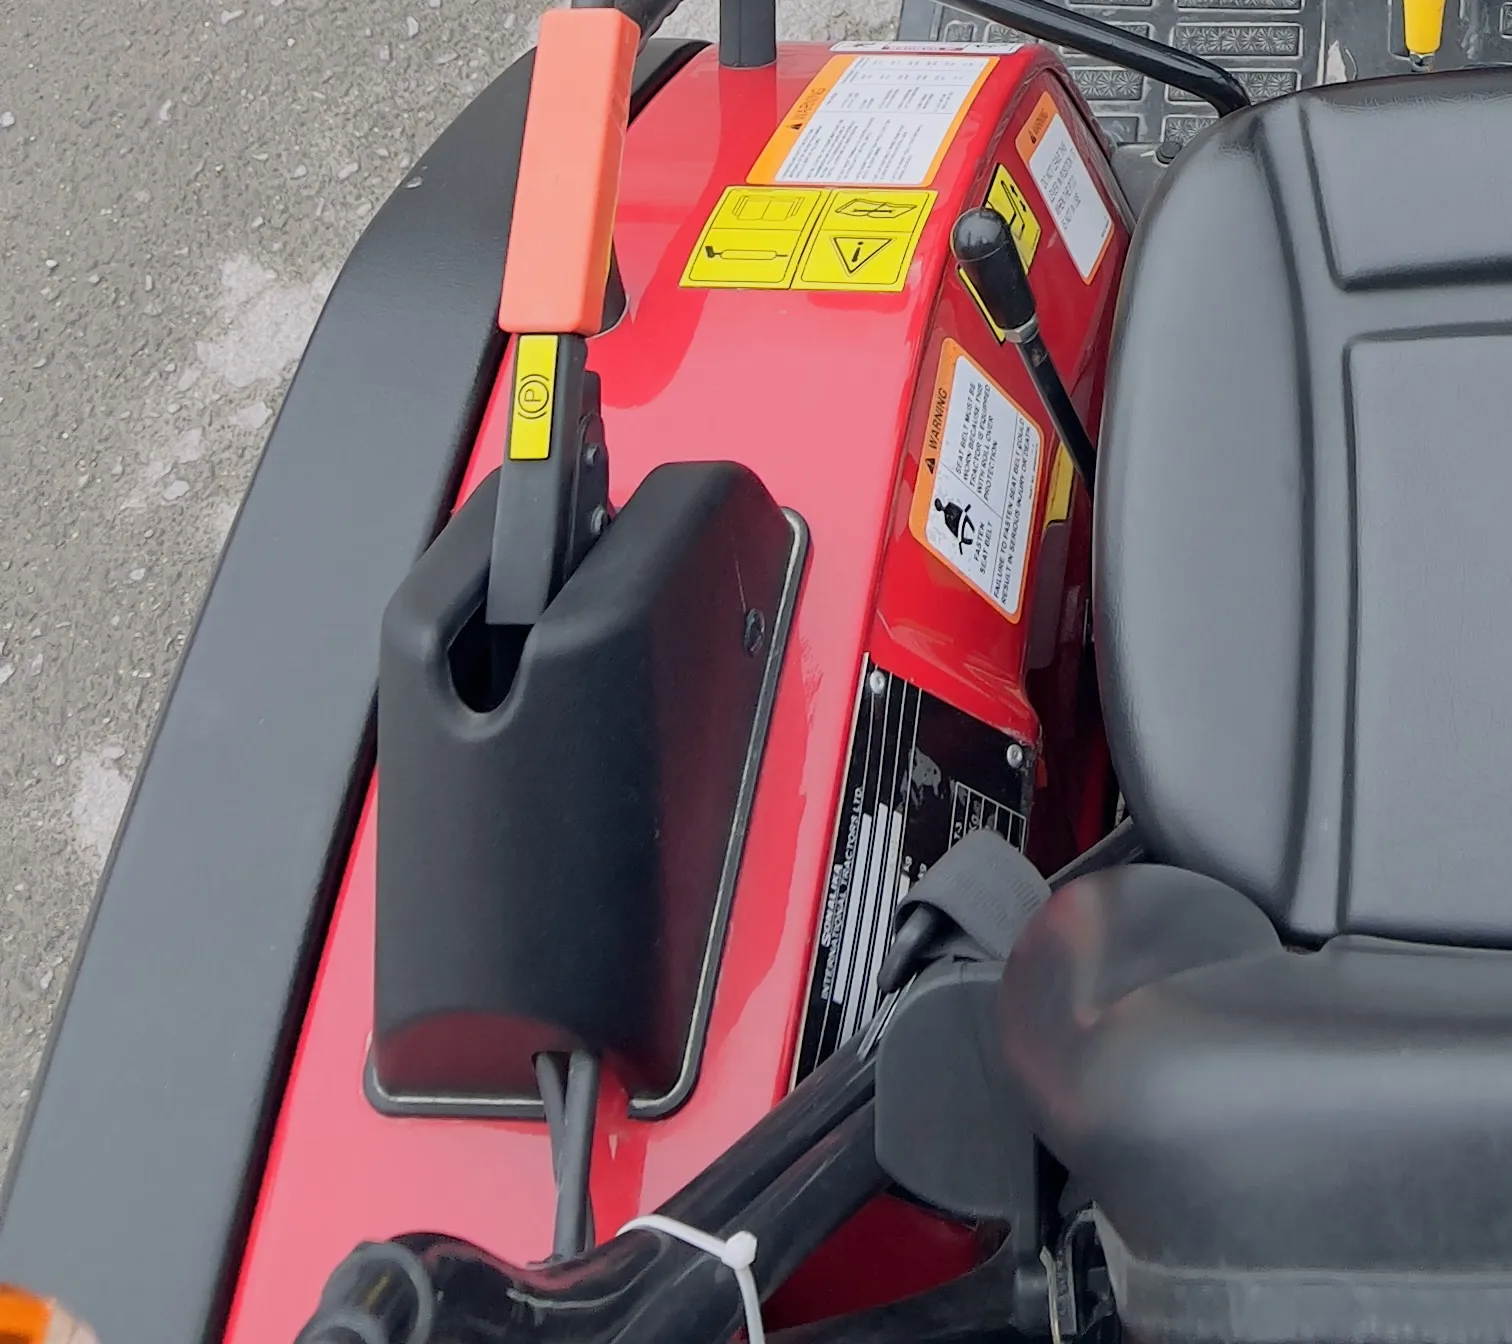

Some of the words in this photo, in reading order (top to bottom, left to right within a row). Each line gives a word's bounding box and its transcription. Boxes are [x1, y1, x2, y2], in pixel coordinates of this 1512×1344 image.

[792, 88, 826, 120] WARNING
[929, 386, 947, 451] WARNING
[956, 450, 964, 474] SEAT
[965, 396, 973, 423] MUST
[969, 382, 976, 396] BE
[963, 451, 972, 481] WORN
[969, 406, 979, 449] BECAUSE
[970, 441, 981, 487] TRACTOR
[979, 384, 991, 430] EQUIPPED
[1017, 418, 1025, 449] COULD
[977, 469, 985, 494] WITH
[981, 441, 989, 468] ROLL
[986, 414, 994, 441] OVER
[984, 439, 998, 501] PROTECTION
[974, 520, 985, 561] FASTEN
[985, 520, 993, 546] BELT
[1001, 565, 1011, 604] RESULT
[1009, 508, 1020, 552] SERIOUS
[1016, 473, 1025, 507] INJURY
[1021, 457, 1027, 472] OR
[1001, 540, 1007, 555] TO
[1003, 501, 1013, 540] FASTEN
[995, 556, 1005, 599] FAILURE
[821, 864, 843, 947] SONALIKA
[821, 891, 847, 1000] INTERNATIONAL
[840, 814, 860, 885] TRACTORS
